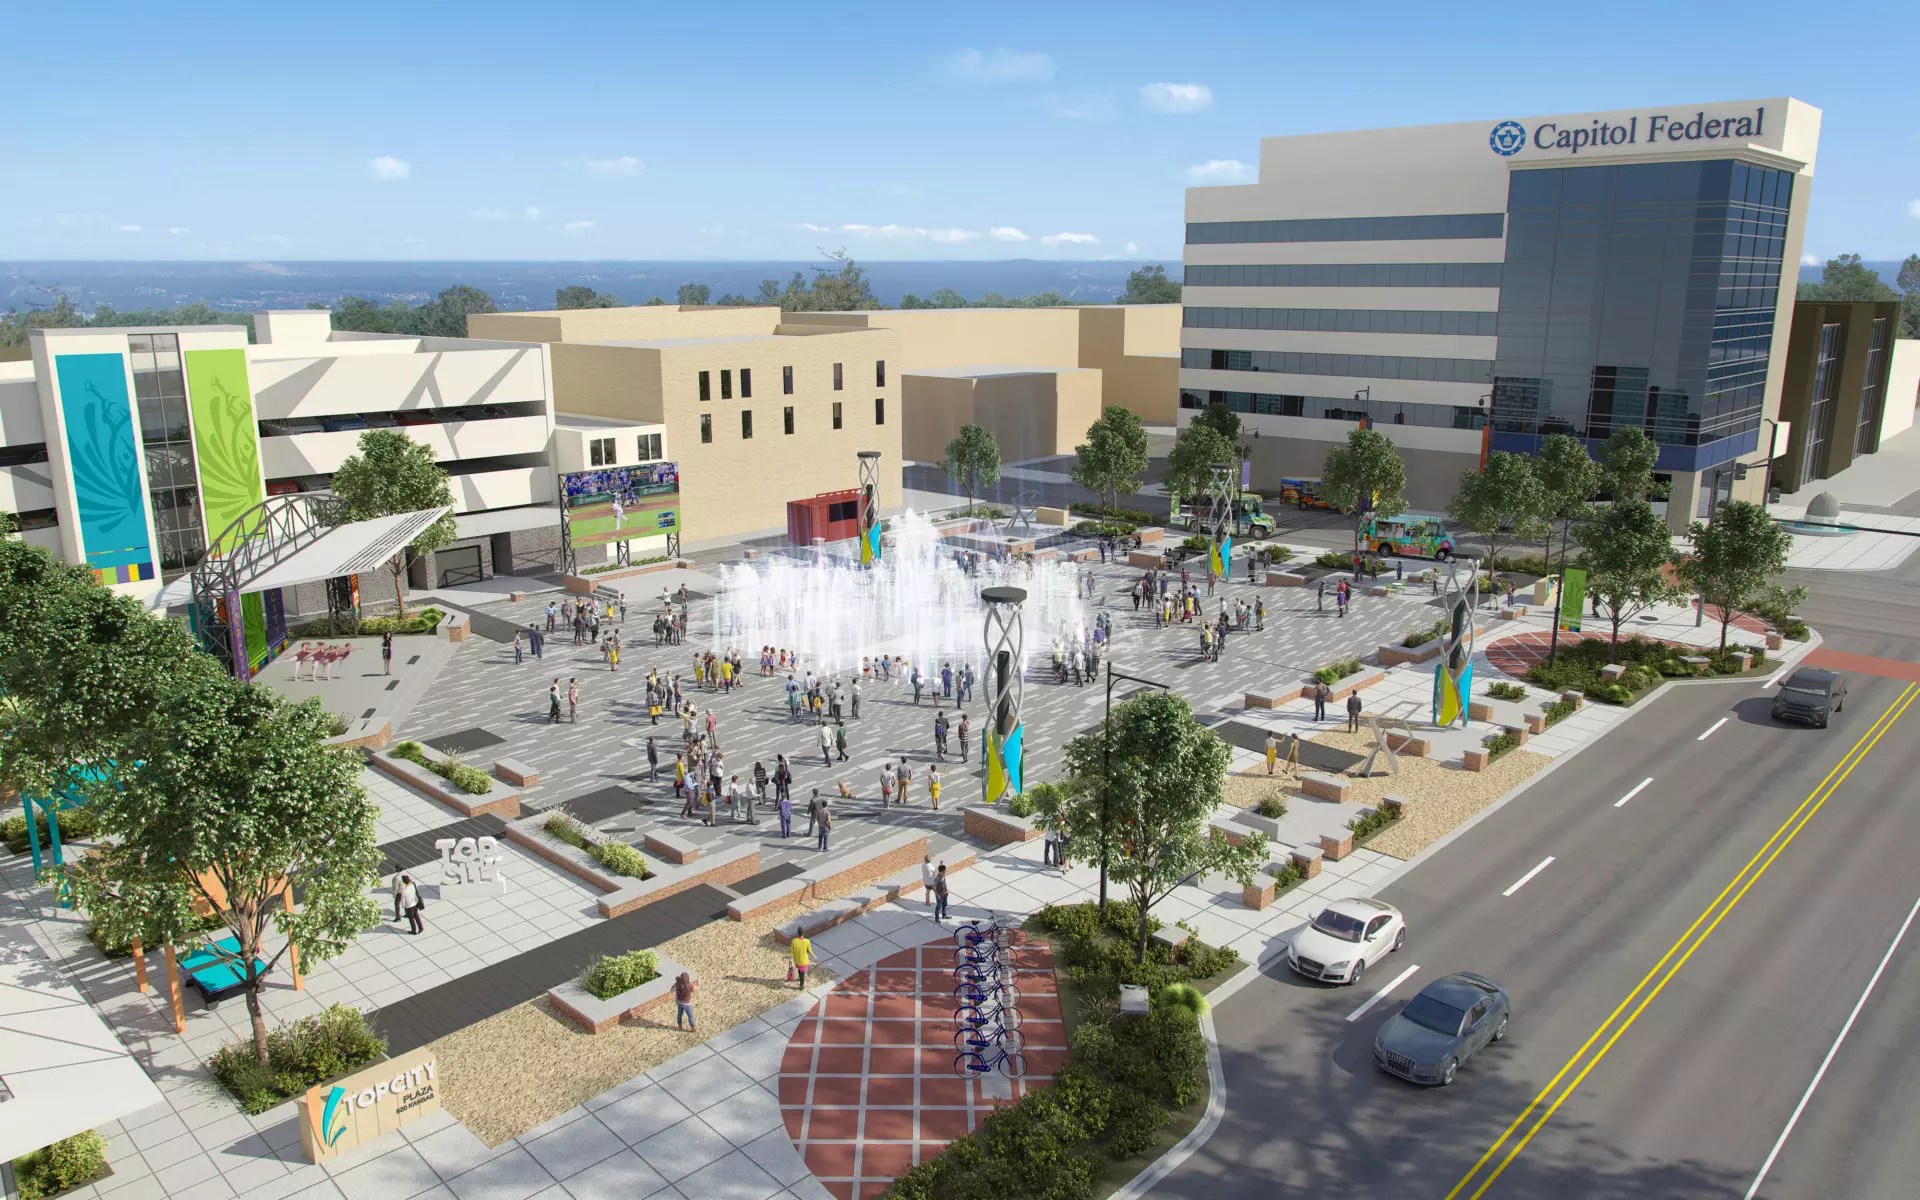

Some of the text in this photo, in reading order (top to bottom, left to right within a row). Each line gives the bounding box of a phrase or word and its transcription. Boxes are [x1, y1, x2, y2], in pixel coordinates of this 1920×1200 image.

[1534, 107, 1764, 153] Capitol Federal
[403, 1084, 433, 1103] PLAZA
